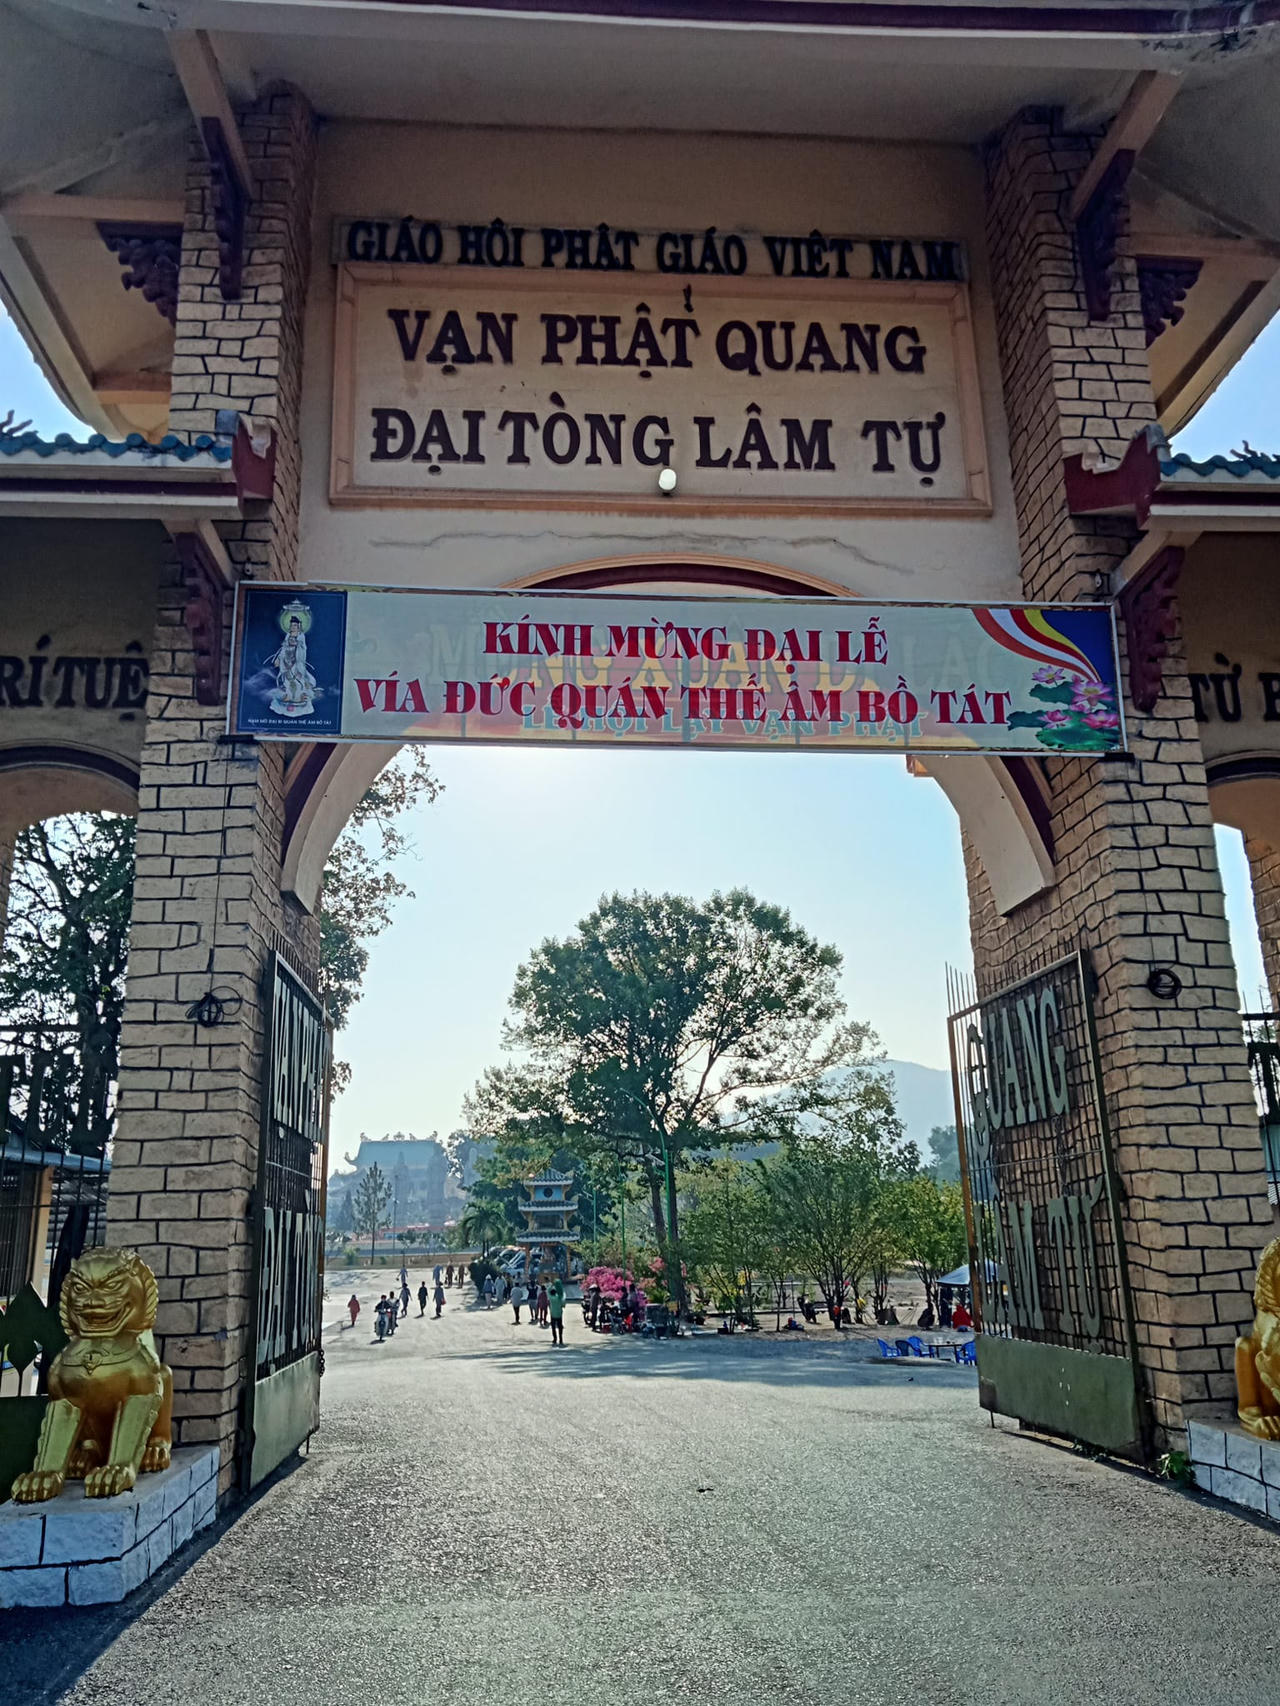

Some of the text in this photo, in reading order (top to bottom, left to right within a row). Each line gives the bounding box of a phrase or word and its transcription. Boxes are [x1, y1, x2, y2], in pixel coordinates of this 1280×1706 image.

[348, 214, 443, 264] GIÁO
[656, 225, 747, 276] GIÁO
[869, 239, 960, 281] NAM
[388, 302, 927, 378] VẠN PHẬT QUANG
[371, 391, 947, 487] ĐẠI TÒNG LÂM TỰ
[482, 614, 888, 674] KÍNH MỪNG ĐẠI LỄ
[353, 671, 1012, 730] VÍA ĐỨC QUÁN THẾ ÂM BỒ TÁT
[966, 985, 1070, 1161] QUANG
